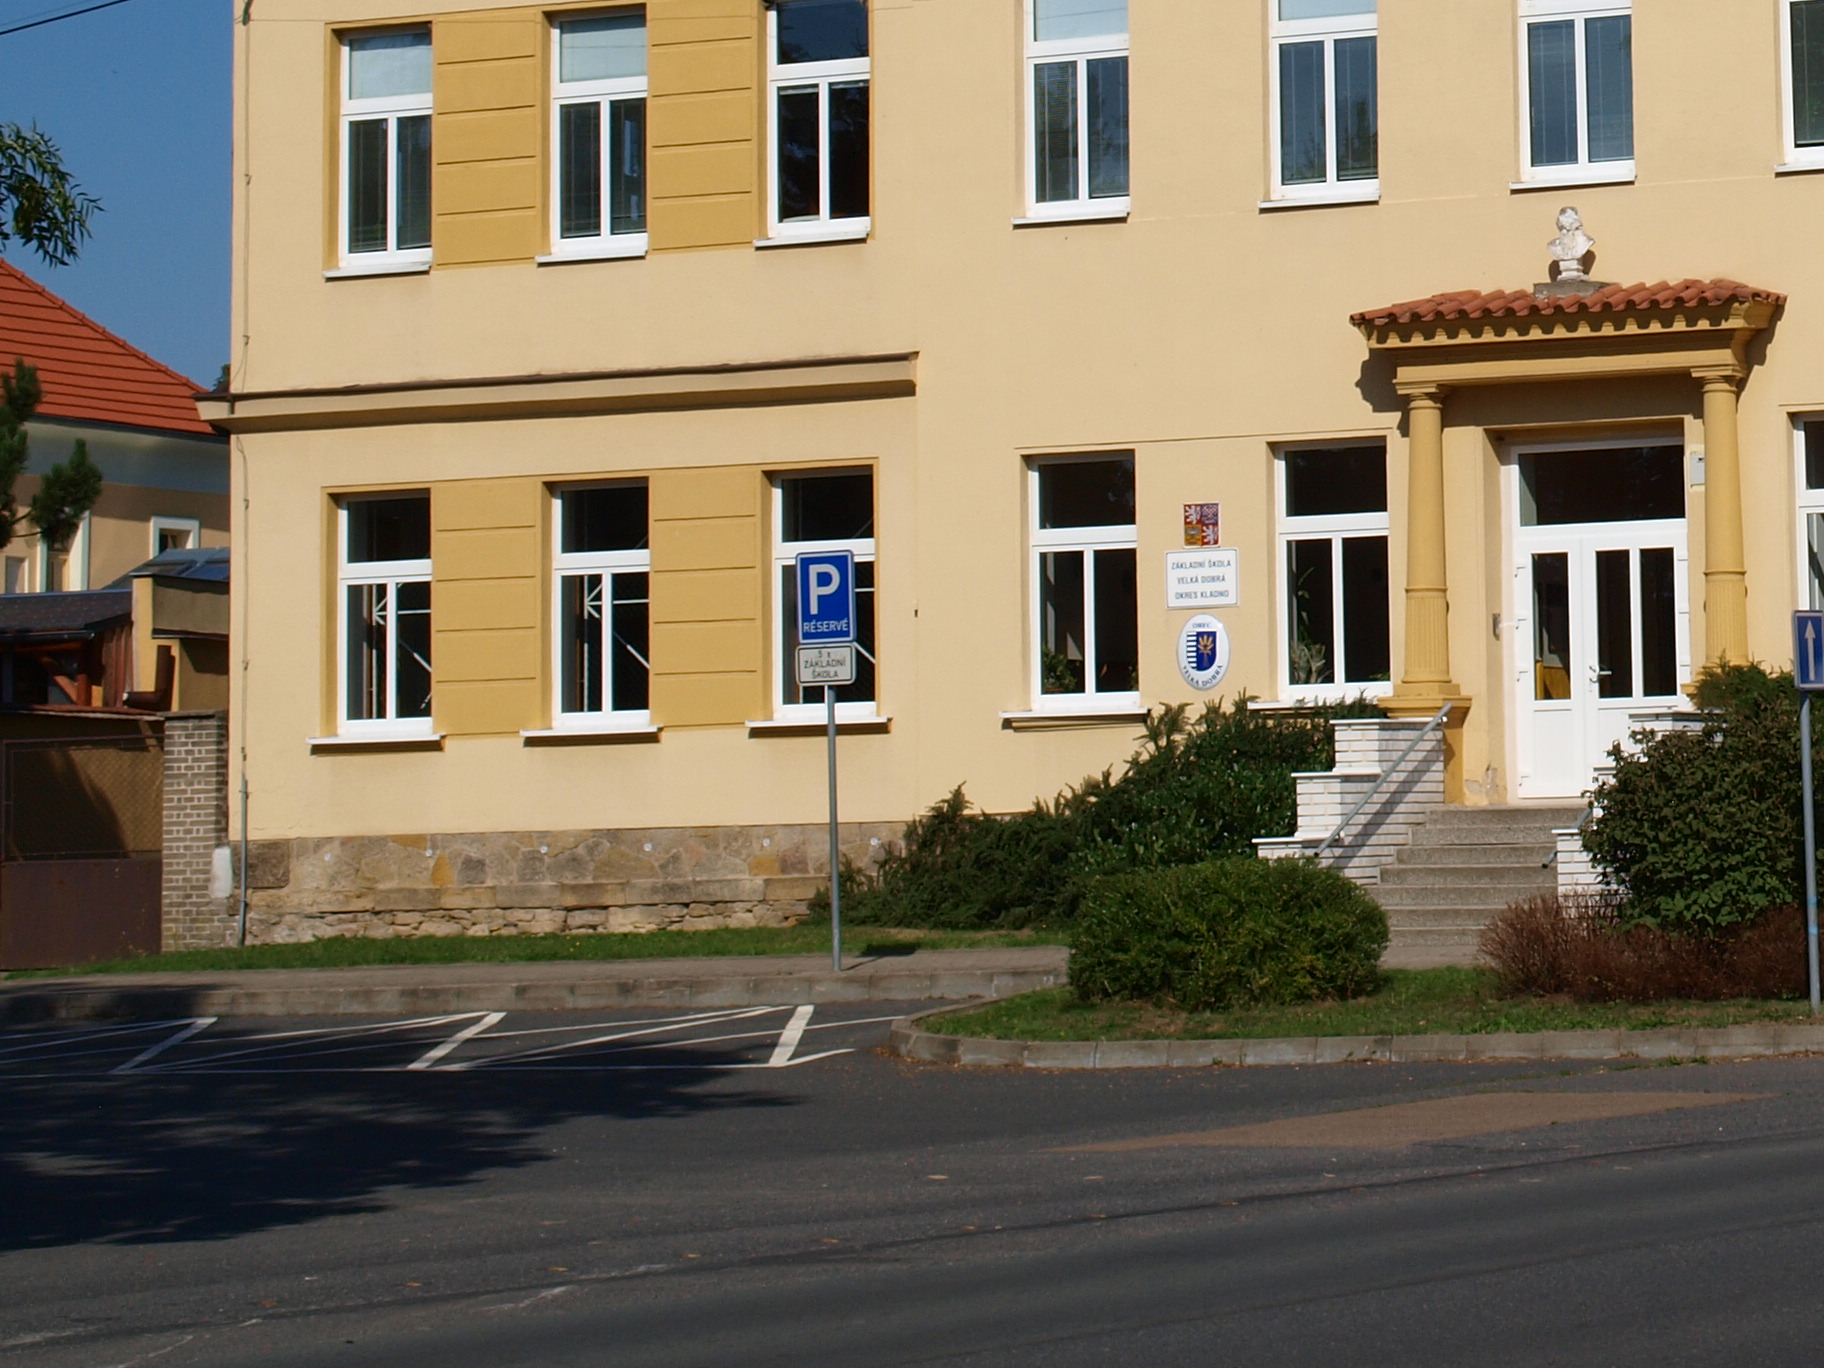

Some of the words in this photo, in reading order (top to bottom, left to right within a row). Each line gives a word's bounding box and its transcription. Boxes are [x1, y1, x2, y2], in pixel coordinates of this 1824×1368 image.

[1171, 560, 1205, 570] ZÁKLADNÍ
[1208, 558, 1231, 568] ŠKOLA
[1177, 575, 1199, 584] VELKÁ
[1201, 574, 1226, 583] DOBRÁ
[809, 564, 840, 615] P
[1175, 591, 1198, 600] OKRES
[1200, 589, 1230, 598] KLADNO
[803, 618, 849, 633] RÉSERVÉ
